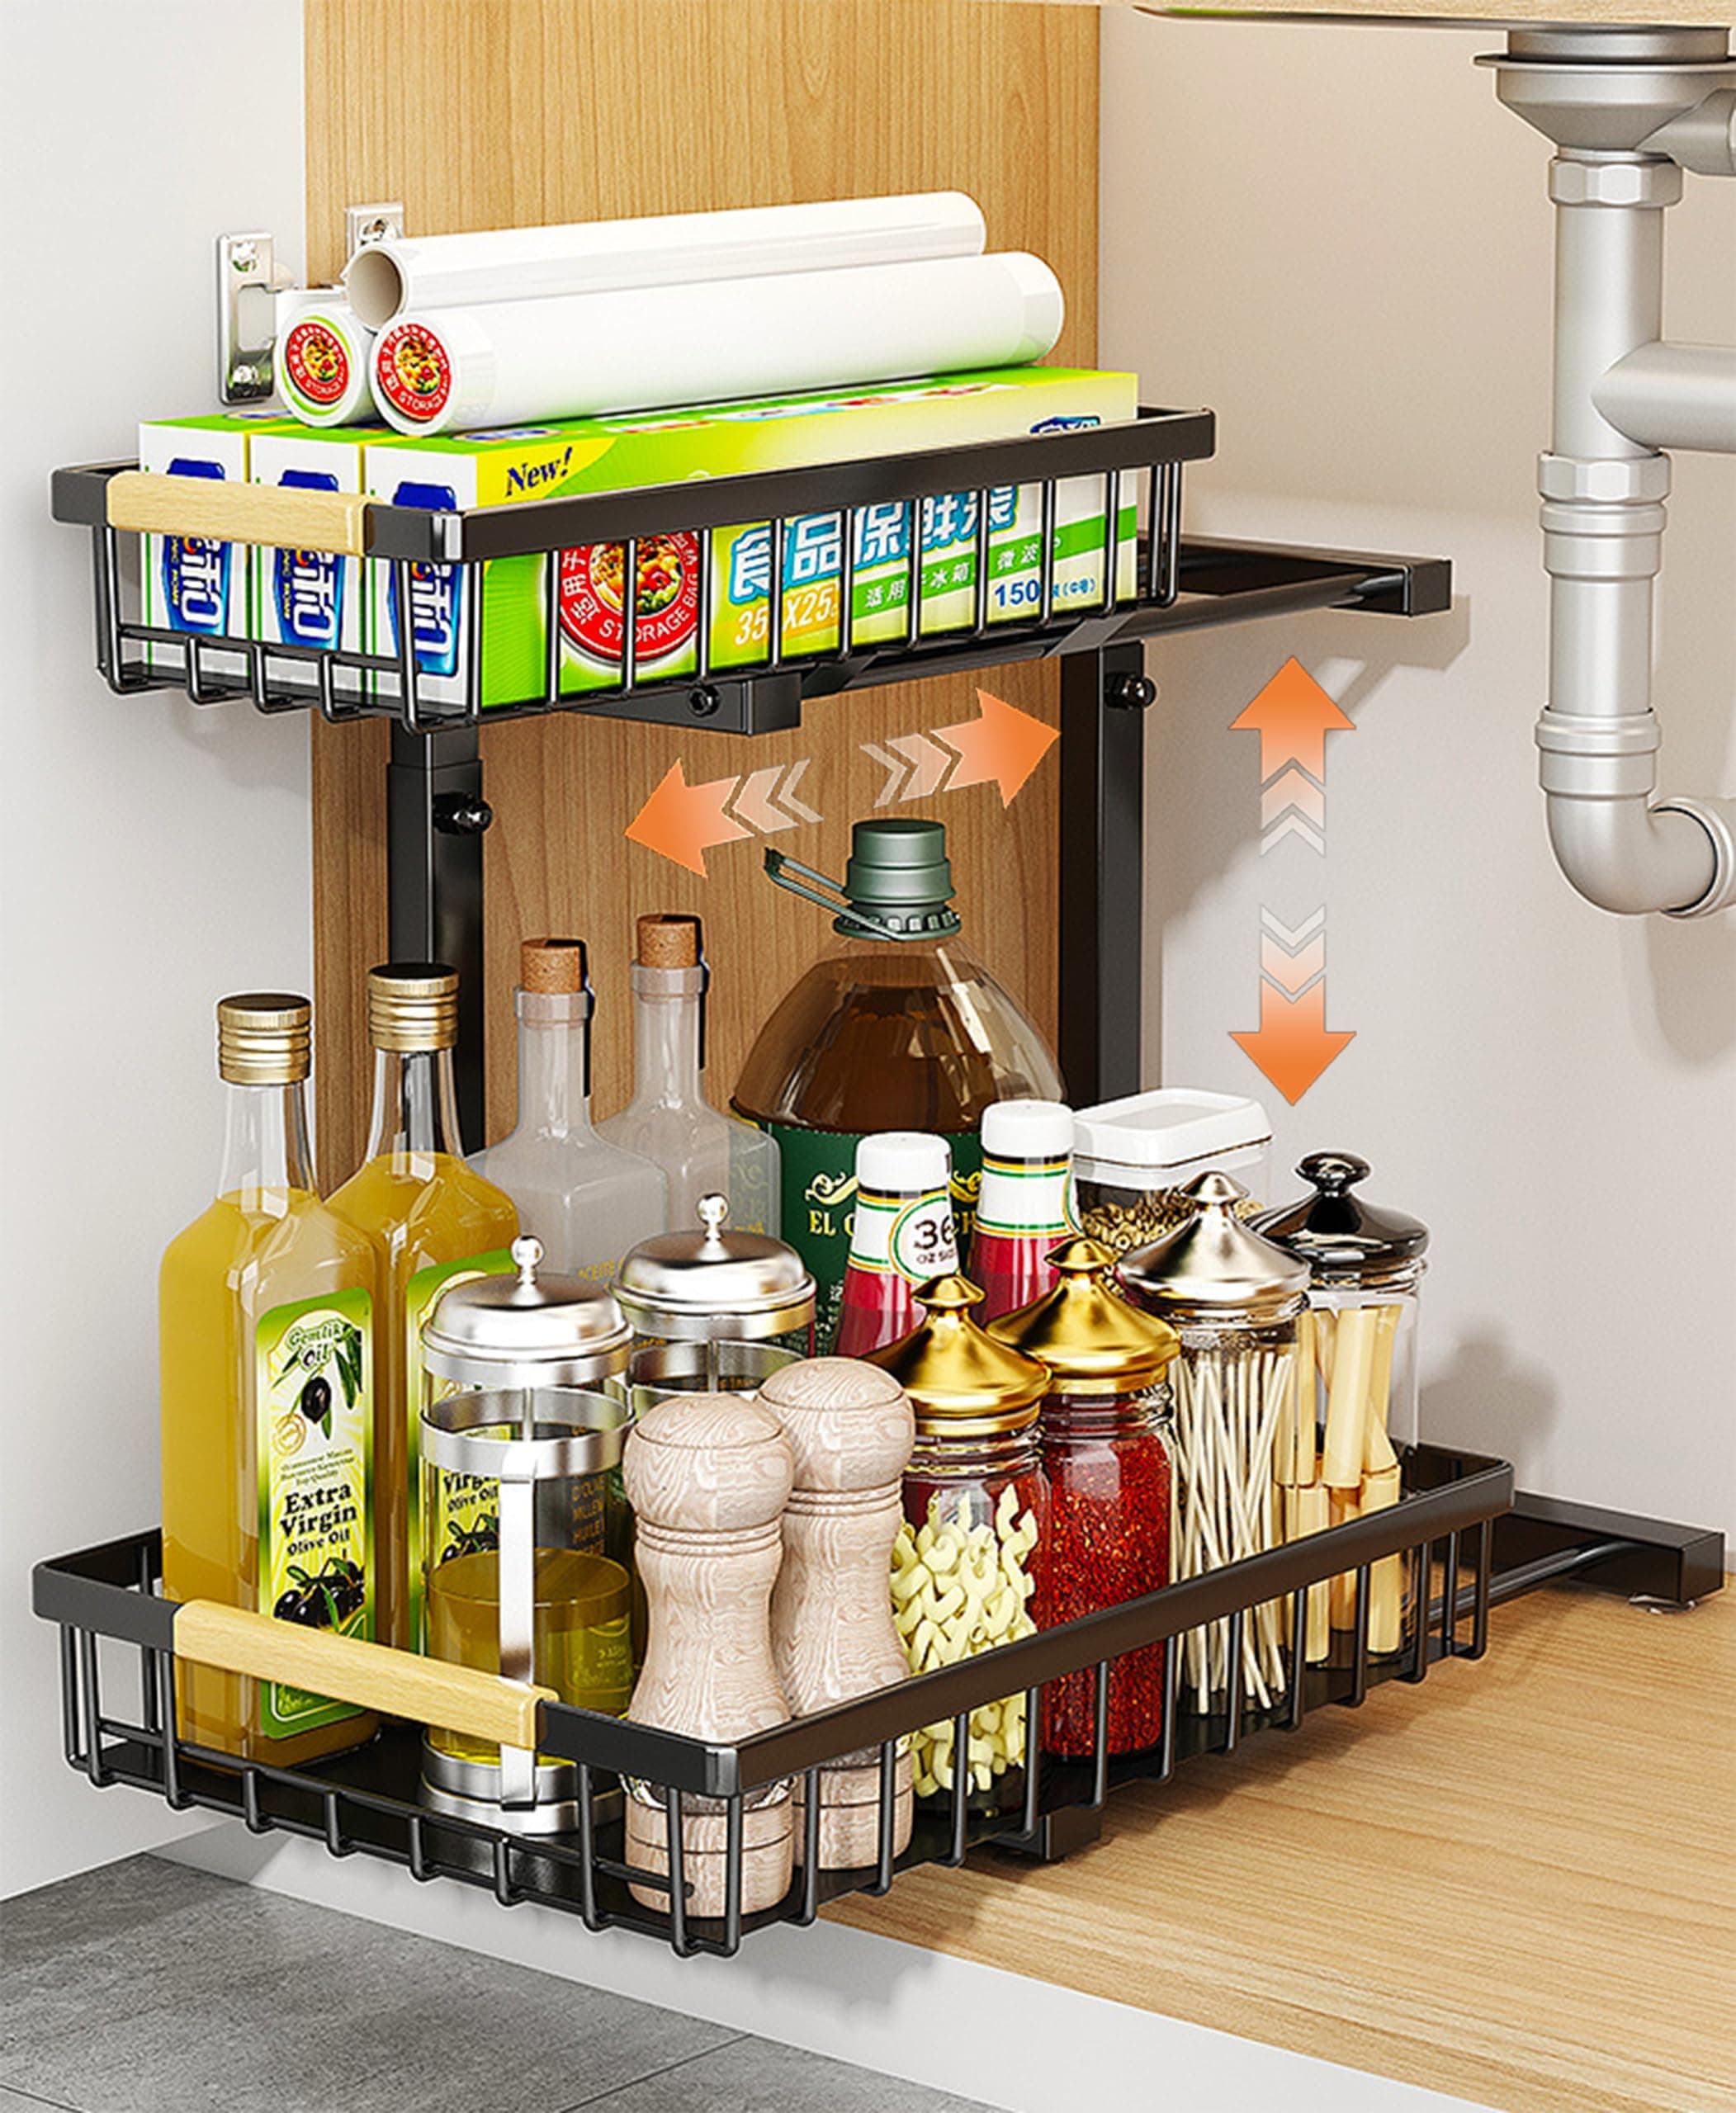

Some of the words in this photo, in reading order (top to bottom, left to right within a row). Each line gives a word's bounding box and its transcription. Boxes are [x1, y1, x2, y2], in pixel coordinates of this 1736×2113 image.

[505, 447, 573, 496] New!
[809, 1210, 835, 1236] EL
[302, 1342, 329, 1368] Oil
[285, 1483, 352, 1516] Extra
[280, 1504, 358, 1539] Virgin
[287, 1537, 324, 1557] Olive
[329, 1529, 350, 1546] Oil
